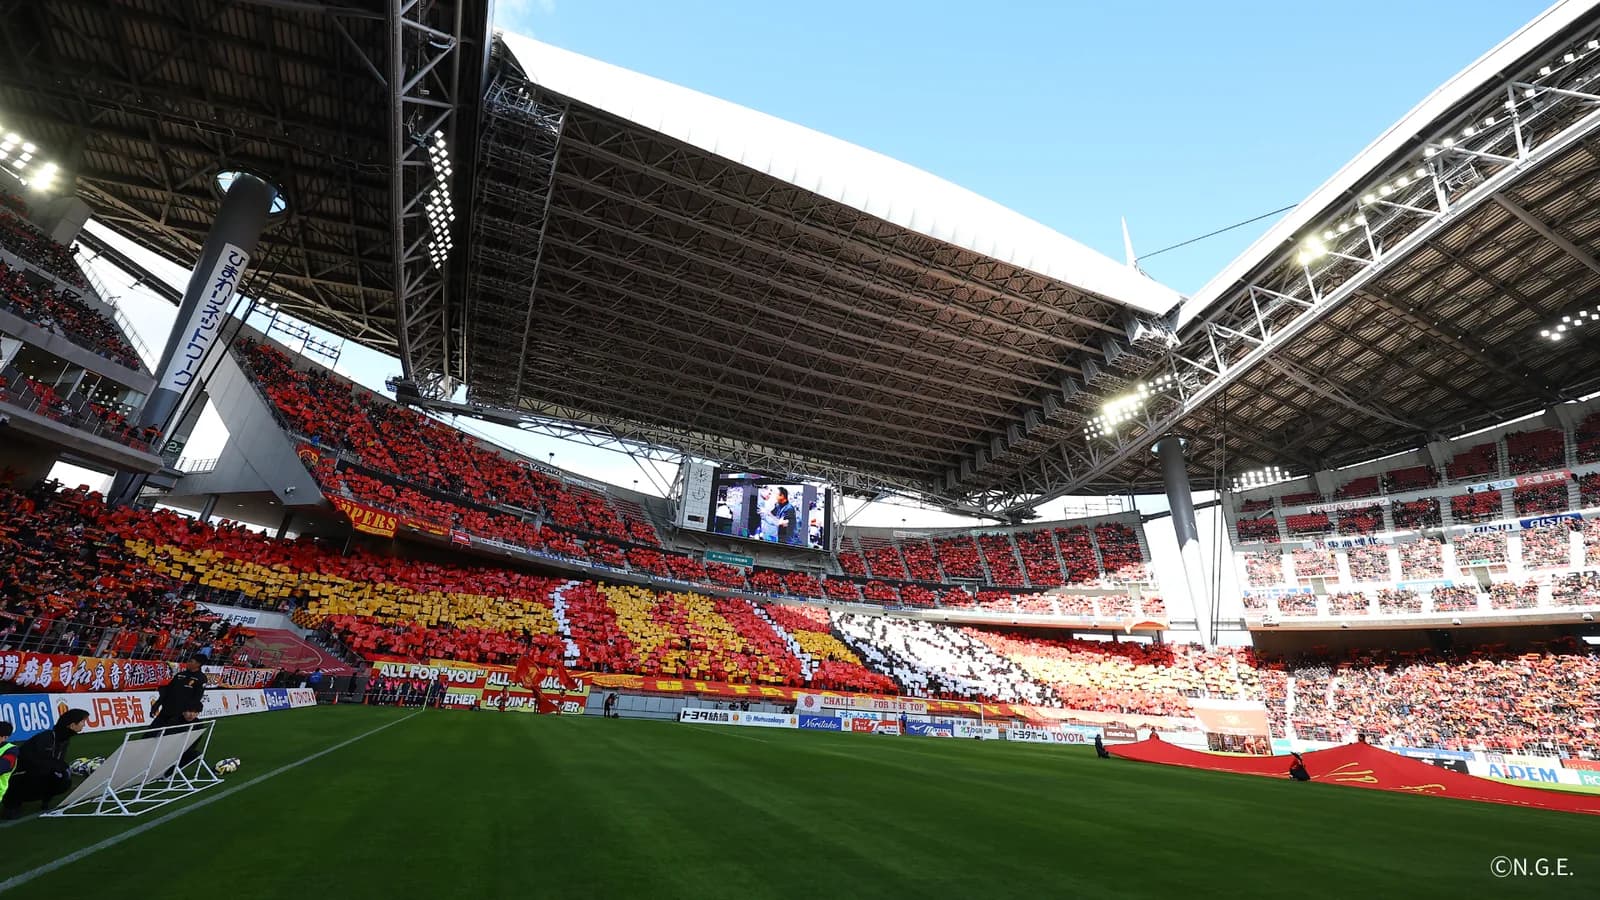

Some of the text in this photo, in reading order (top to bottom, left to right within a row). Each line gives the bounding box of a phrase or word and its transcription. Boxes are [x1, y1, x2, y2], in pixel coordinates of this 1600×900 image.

[380, 664, 407, 678] ALL
[409, 665, 440, 680] FOR
[487, 671, 509, 686] ALL
[442, 693, 476, 705] ETHER
[873, 700, 891, 709] FOR
[910, 702, 924, 711] TOP
[18, 701, 51, 732] GAS
[87, 696, 146, 728] JR東海
[801, 717, 840, 730] Noritake
[1051, 732, 1085, 743] TOYOTA
